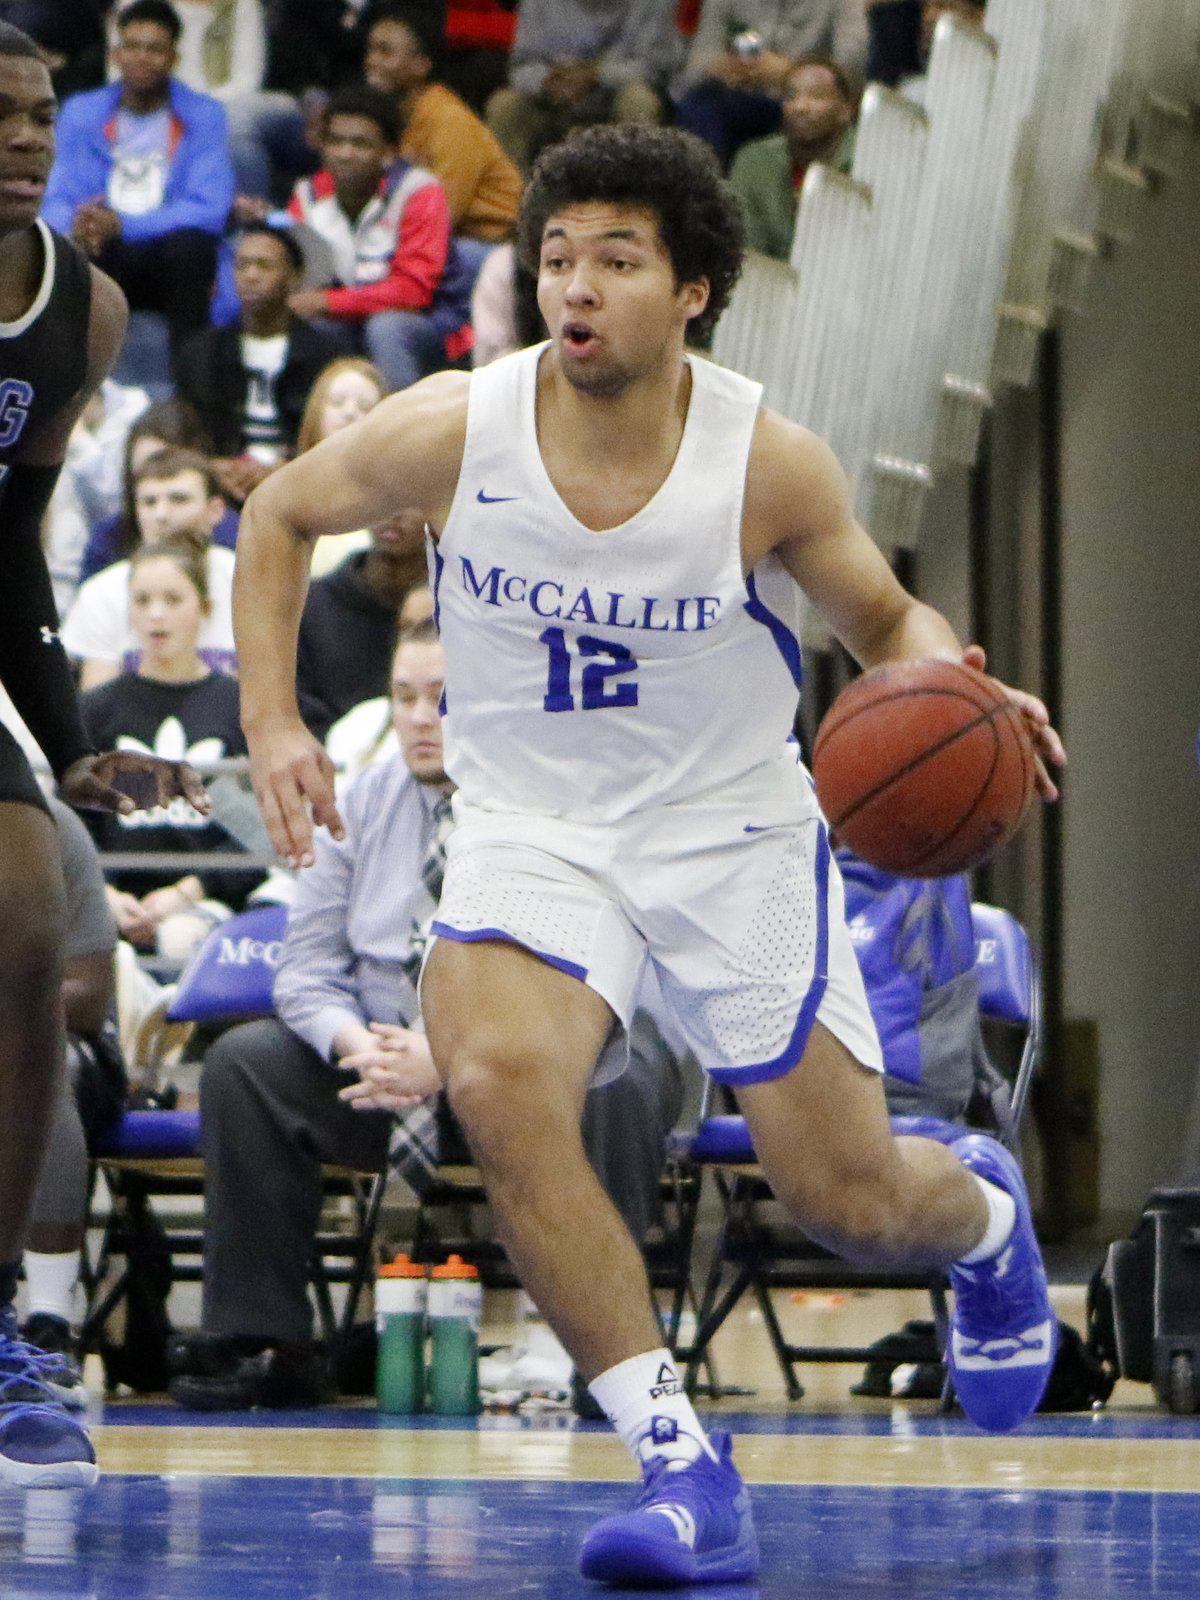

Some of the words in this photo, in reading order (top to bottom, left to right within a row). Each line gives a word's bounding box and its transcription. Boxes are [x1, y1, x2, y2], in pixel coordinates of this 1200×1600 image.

[458, 555, 721, 632] McCALLIE
[539, 626, 639, 712] 12
[217, 936, 284, 966] McC
